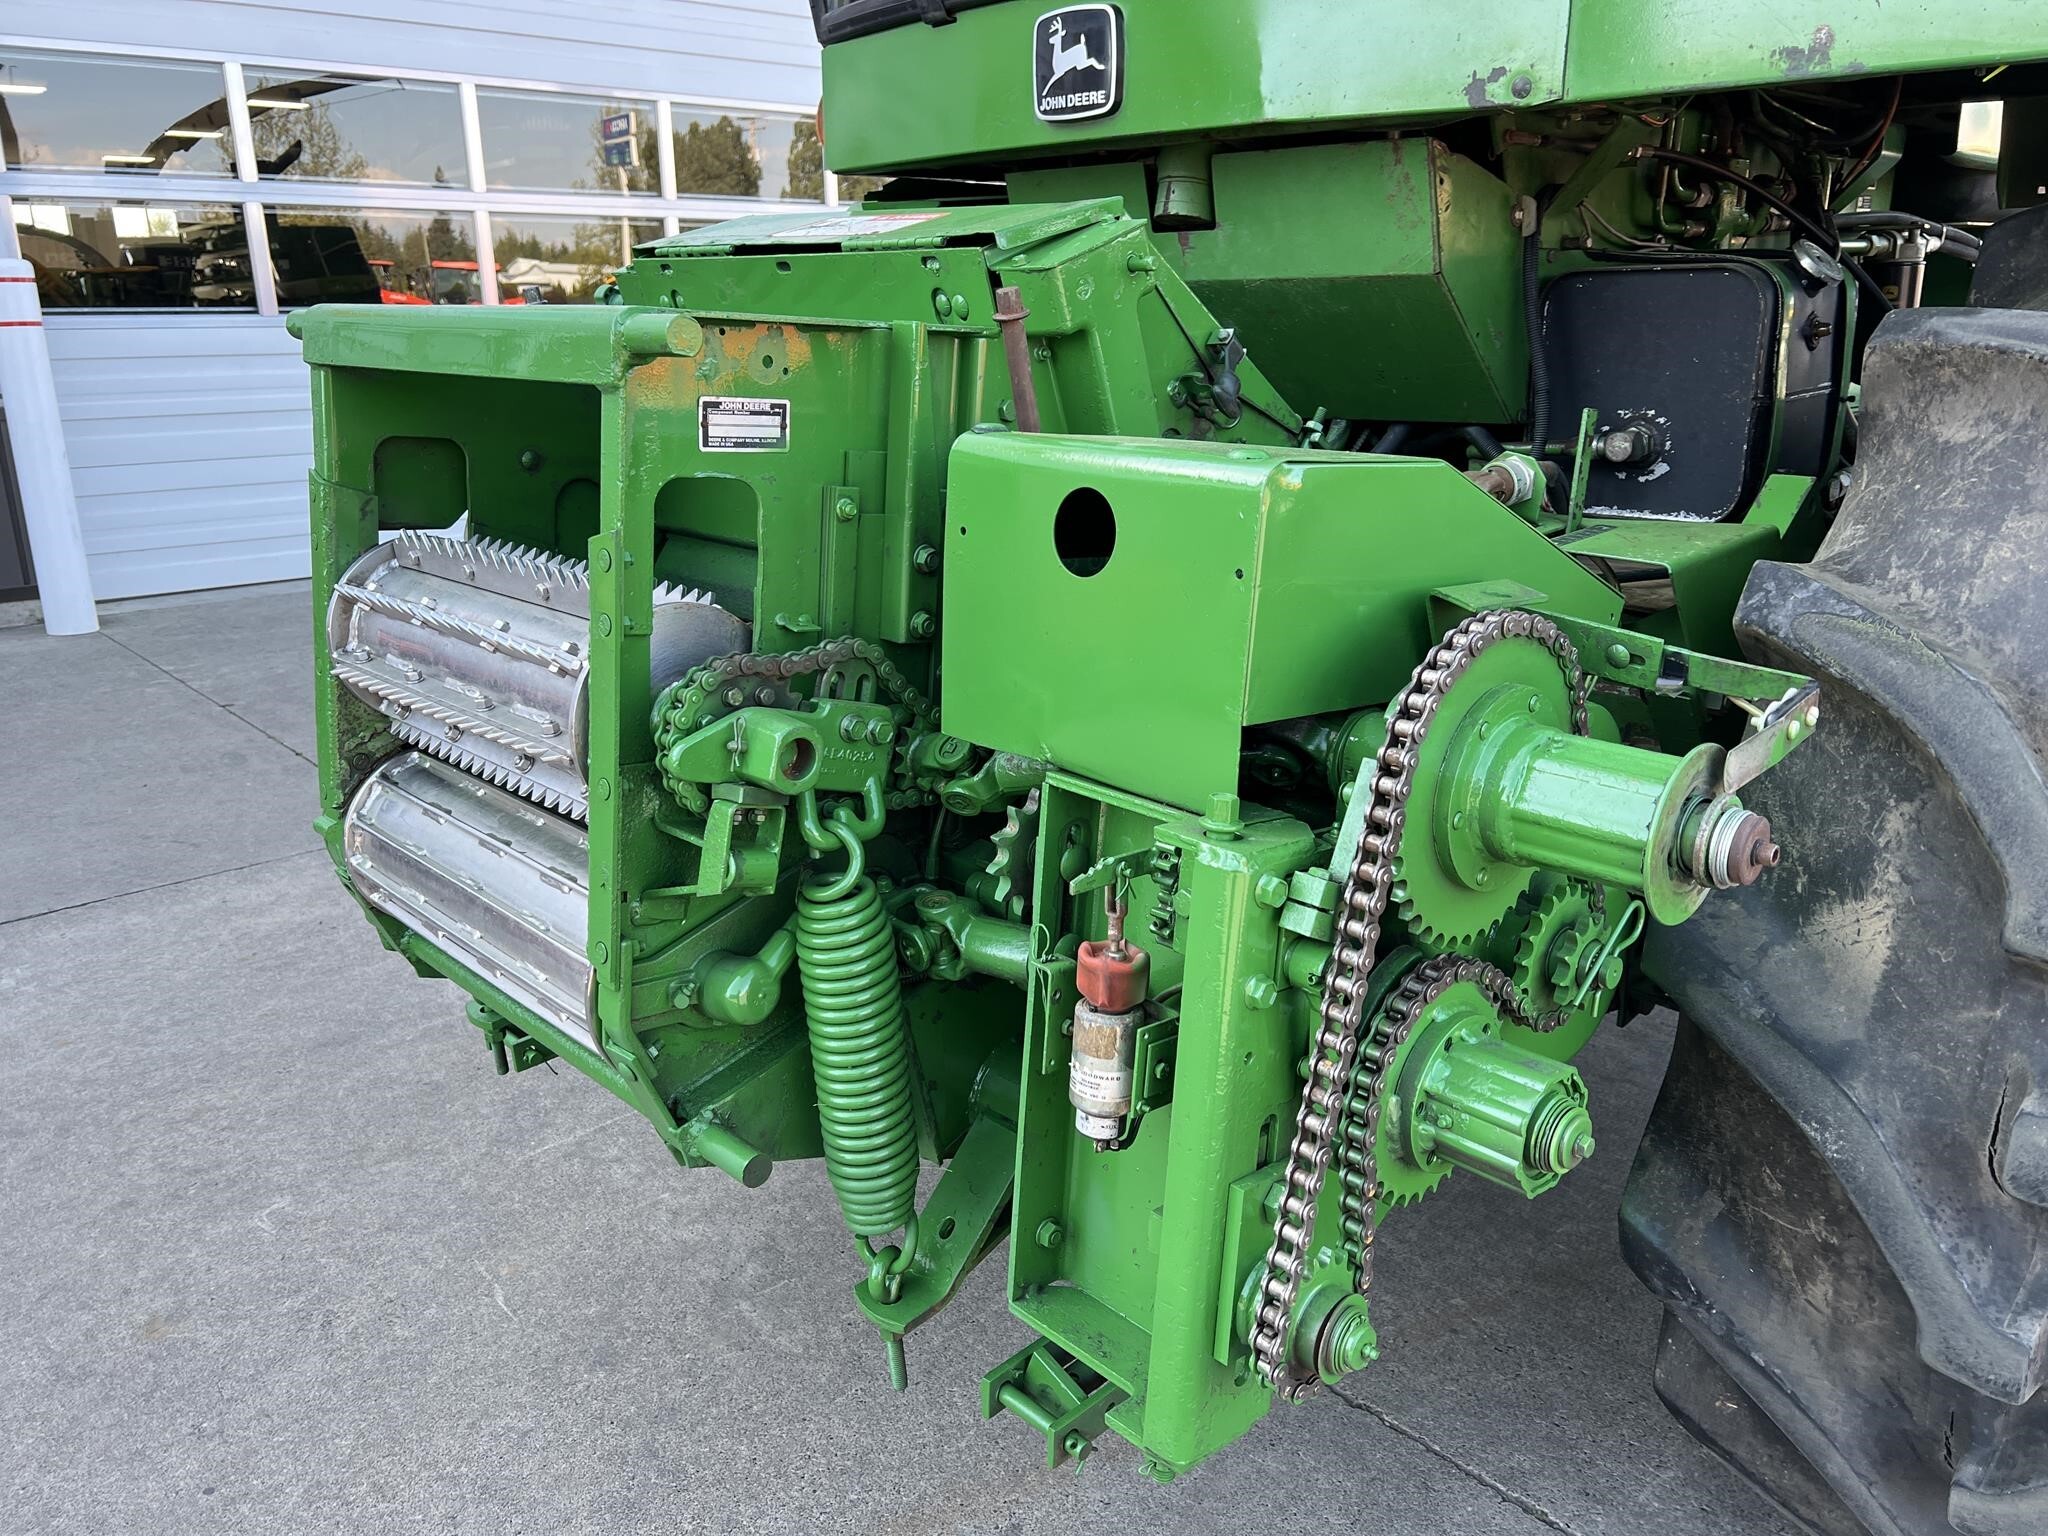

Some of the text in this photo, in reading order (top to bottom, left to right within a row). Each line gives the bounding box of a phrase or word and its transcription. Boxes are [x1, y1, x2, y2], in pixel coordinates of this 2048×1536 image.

[1040, 90, 1106, 111] JOHN DEERE
[719, 401, 771, 411] JOHN DEERE
